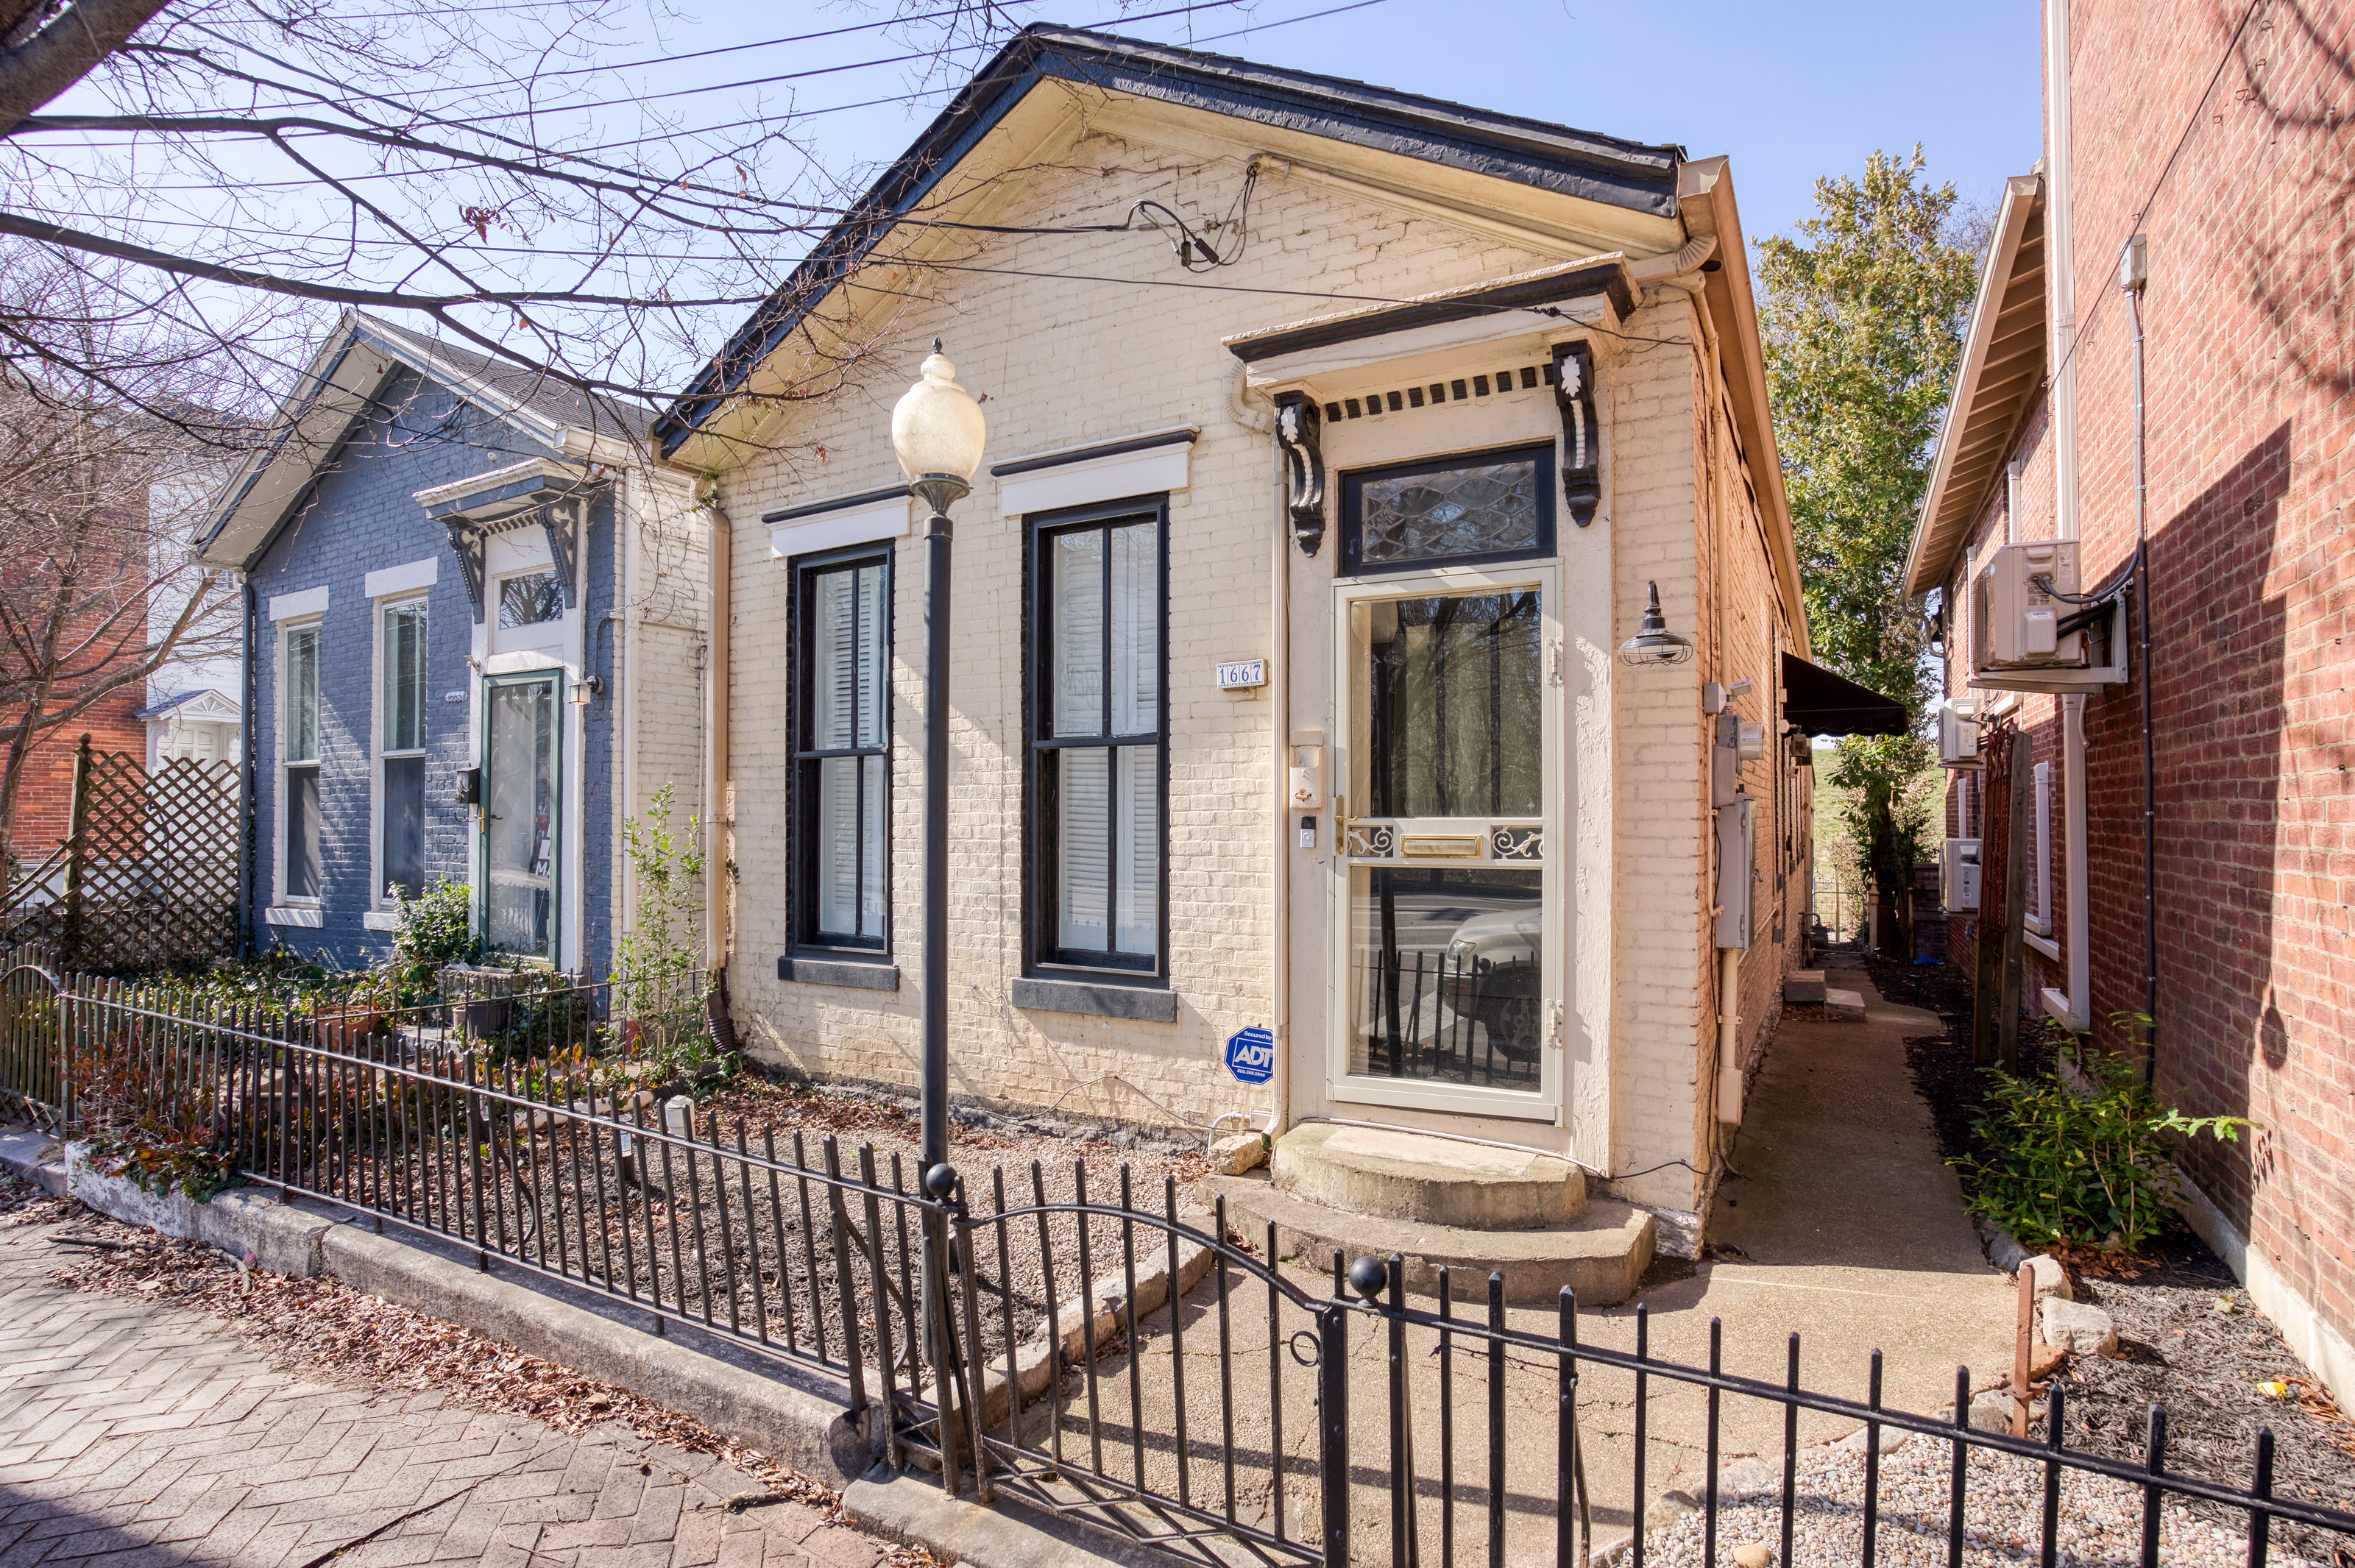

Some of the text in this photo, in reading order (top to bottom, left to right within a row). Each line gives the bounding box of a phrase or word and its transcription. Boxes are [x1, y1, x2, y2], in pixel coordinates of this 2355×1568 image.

[1219, 664, 1261, 684] 1667
[1244, 1031, 1265, 1039] Secured
[1234, 1044, 1273, 1068] ADT
